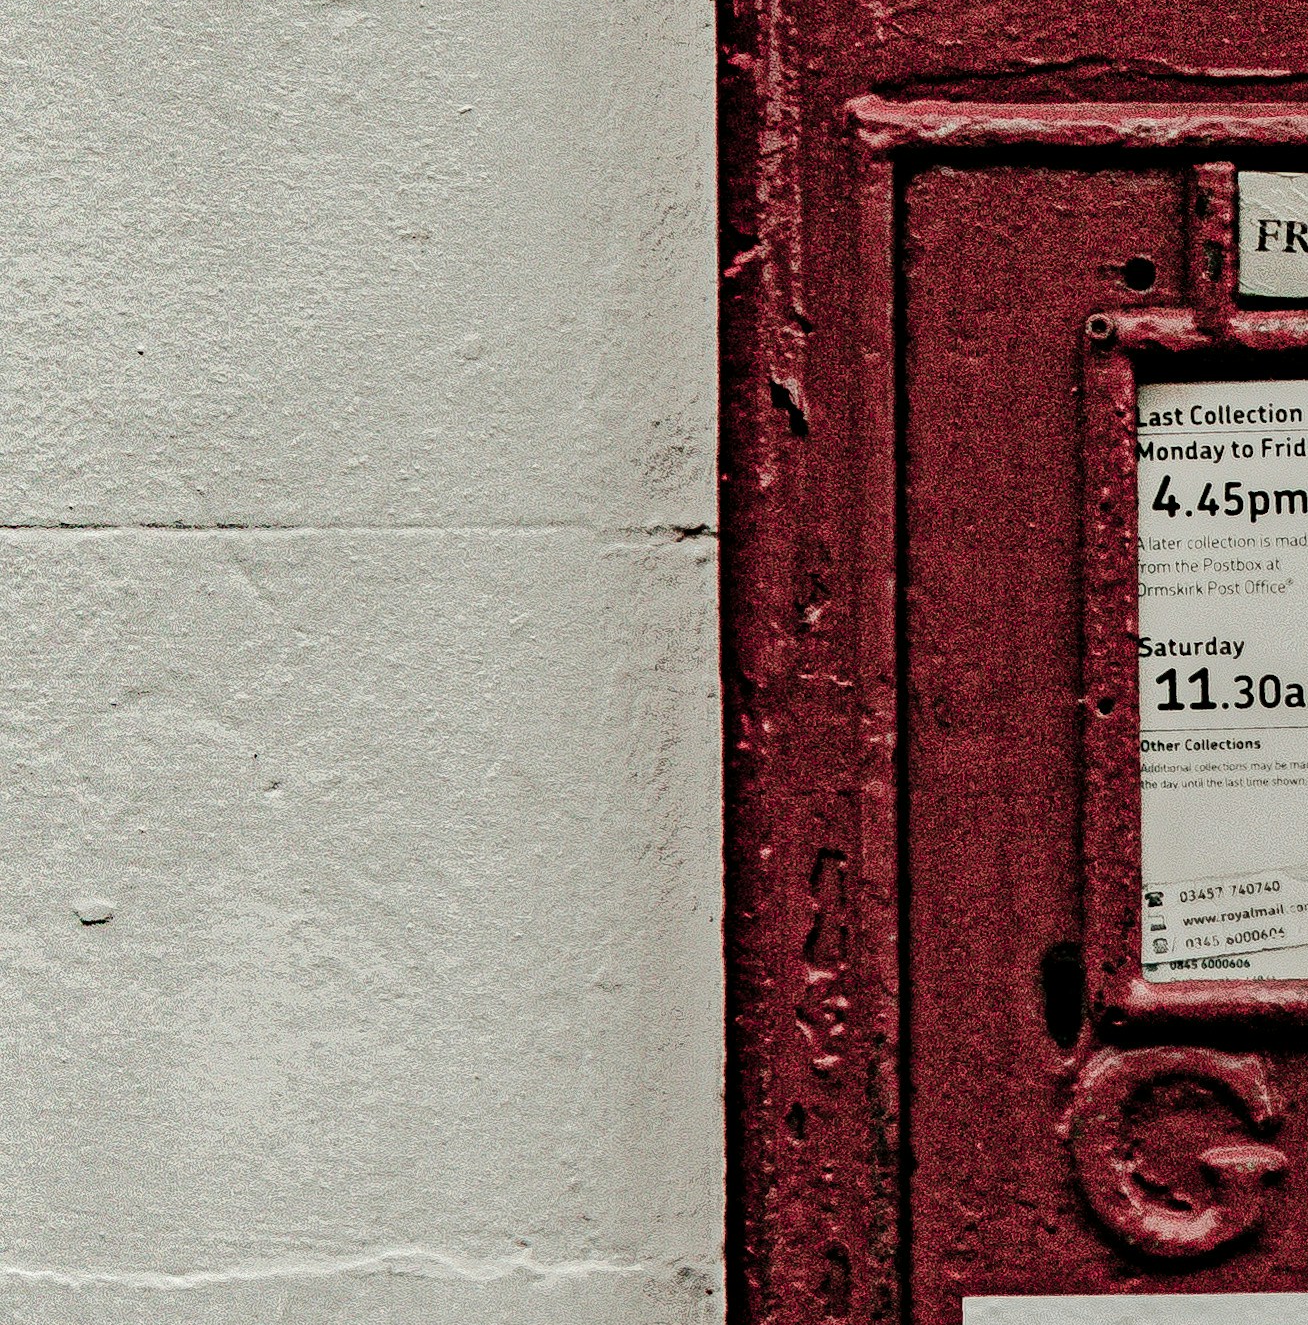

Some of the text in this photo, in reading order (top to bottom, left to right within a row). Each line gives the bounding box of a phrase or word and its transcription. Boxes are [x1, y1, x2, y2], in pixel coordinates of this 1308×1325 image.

[1137, 408, 1184, 427] Last
[1190, 404, 1302, 425] Collection
[1137, 441, 1225, 463] Monday
[1232, 441, 1254, 459] to
[1151, 475, 1308, 523] 4.45pm
[1149, 536, 1182, 550] later
[1187, 536, 1256, 549] collection
[1261, 535, 1270, 548] is
[1175, 558, 1198, 572] the
[1203, 557, 1262, 572] Postbox
[1266, 557, 1280, 570] at
[1138, 581, 1203, 597] Ormskirk
[1208, 580, 1240, 595] Post
[1140, 637, 1244, 658] Saturday
[1140, 738, 1261, 753] Other Collections
[1141, 762, 1191, 774] Additional
[1194, 760, 1247, 772] collections
[1251, 761, 1272, 772] may
[1161, 779, 1179, 791] day
[1206, 777, 1223, 788] the
[1179, 880, 1281, 903] 03457 740740
[1200, 958, 1251, 970] 6000606
